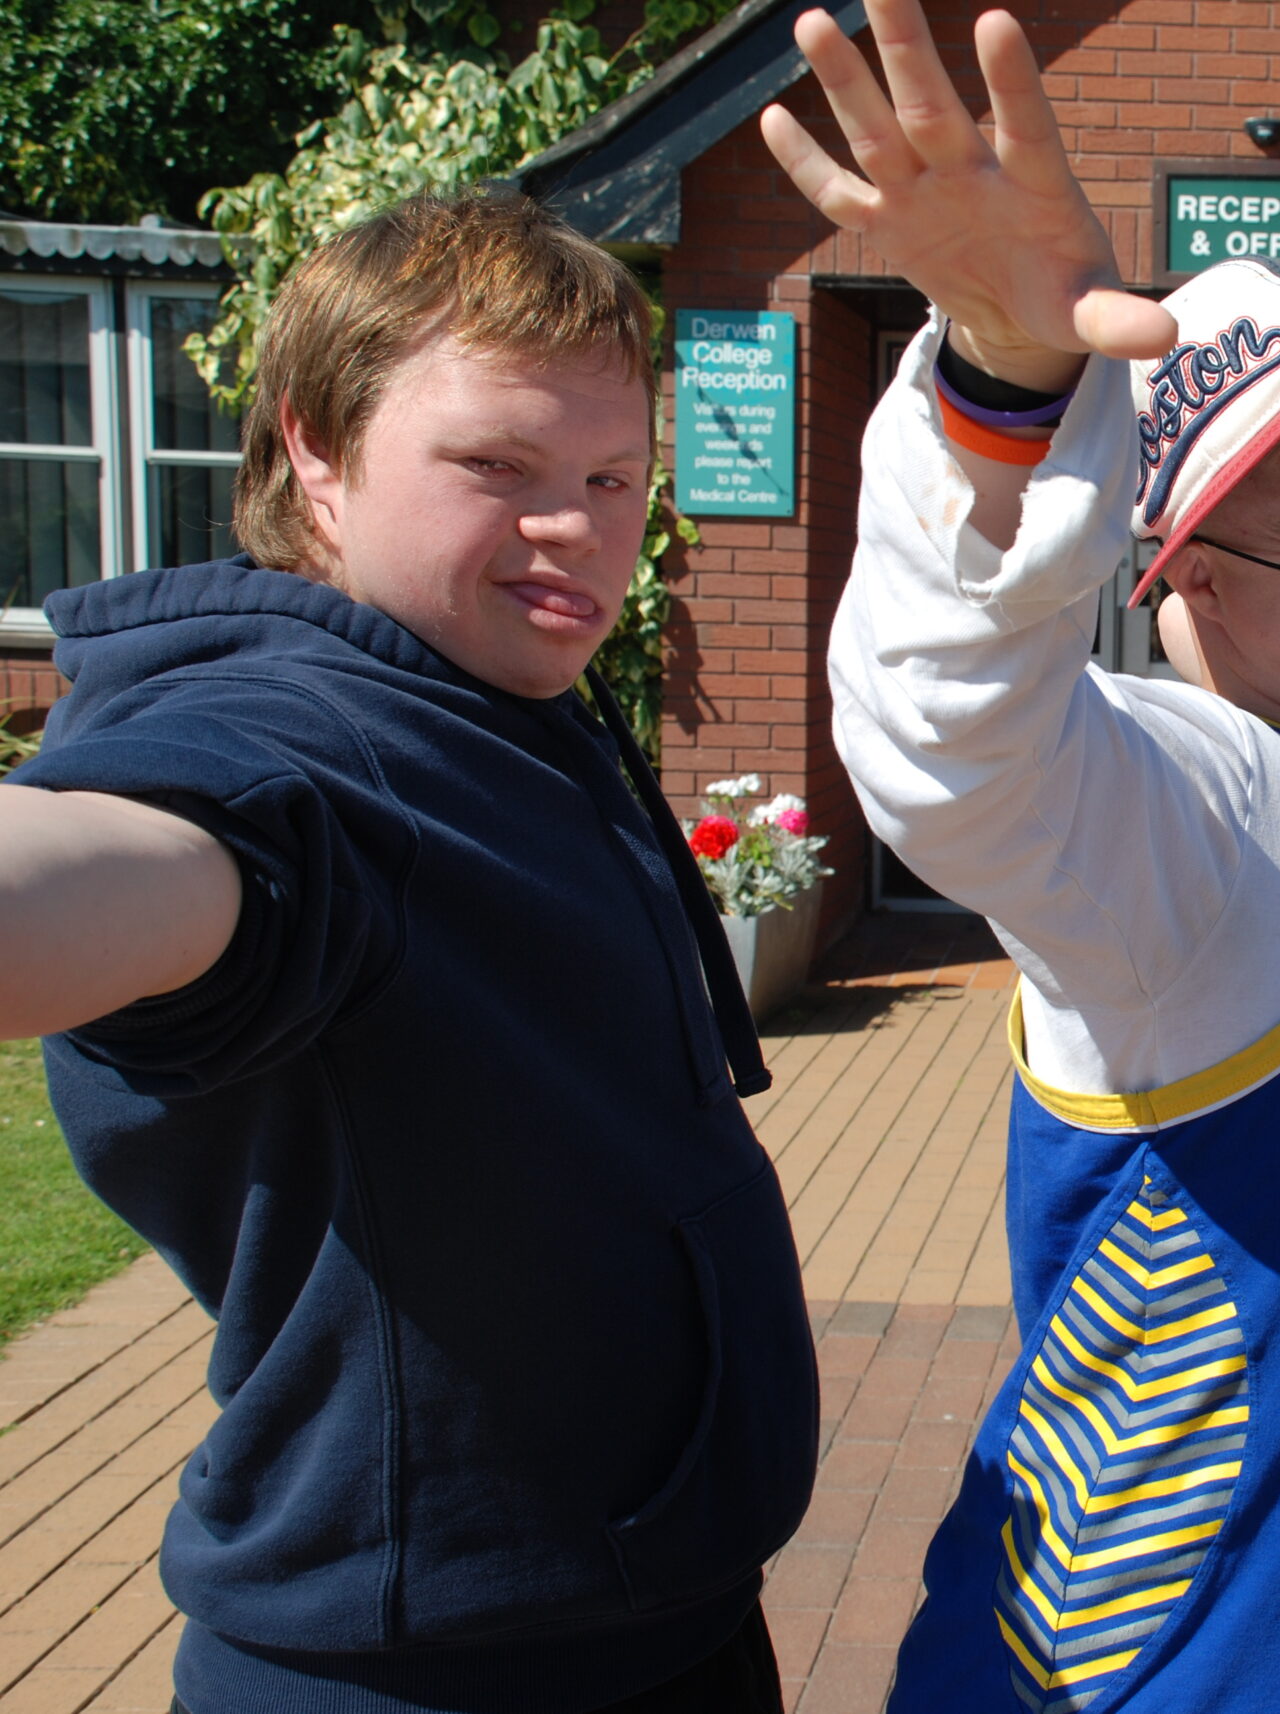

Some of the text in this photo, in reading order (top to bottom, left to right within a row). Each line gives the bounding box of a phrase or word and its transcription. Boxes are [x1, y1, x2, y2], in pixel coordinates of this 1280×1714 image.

[1190, 230, 1211, 256] &
[691, 317, 776, 340] Derwen
[692, 341, 773, 368] College
[682, 366, 787, 393] Reception
[739, 404, 776, 420] during
[749, 421, 773, 435] and
[704, 439, 764, 451] weekds
[694, 455, 734, 469] please
[716, 473, 752, 485] to the
[690, 488, 778, 503] Medical Centre
